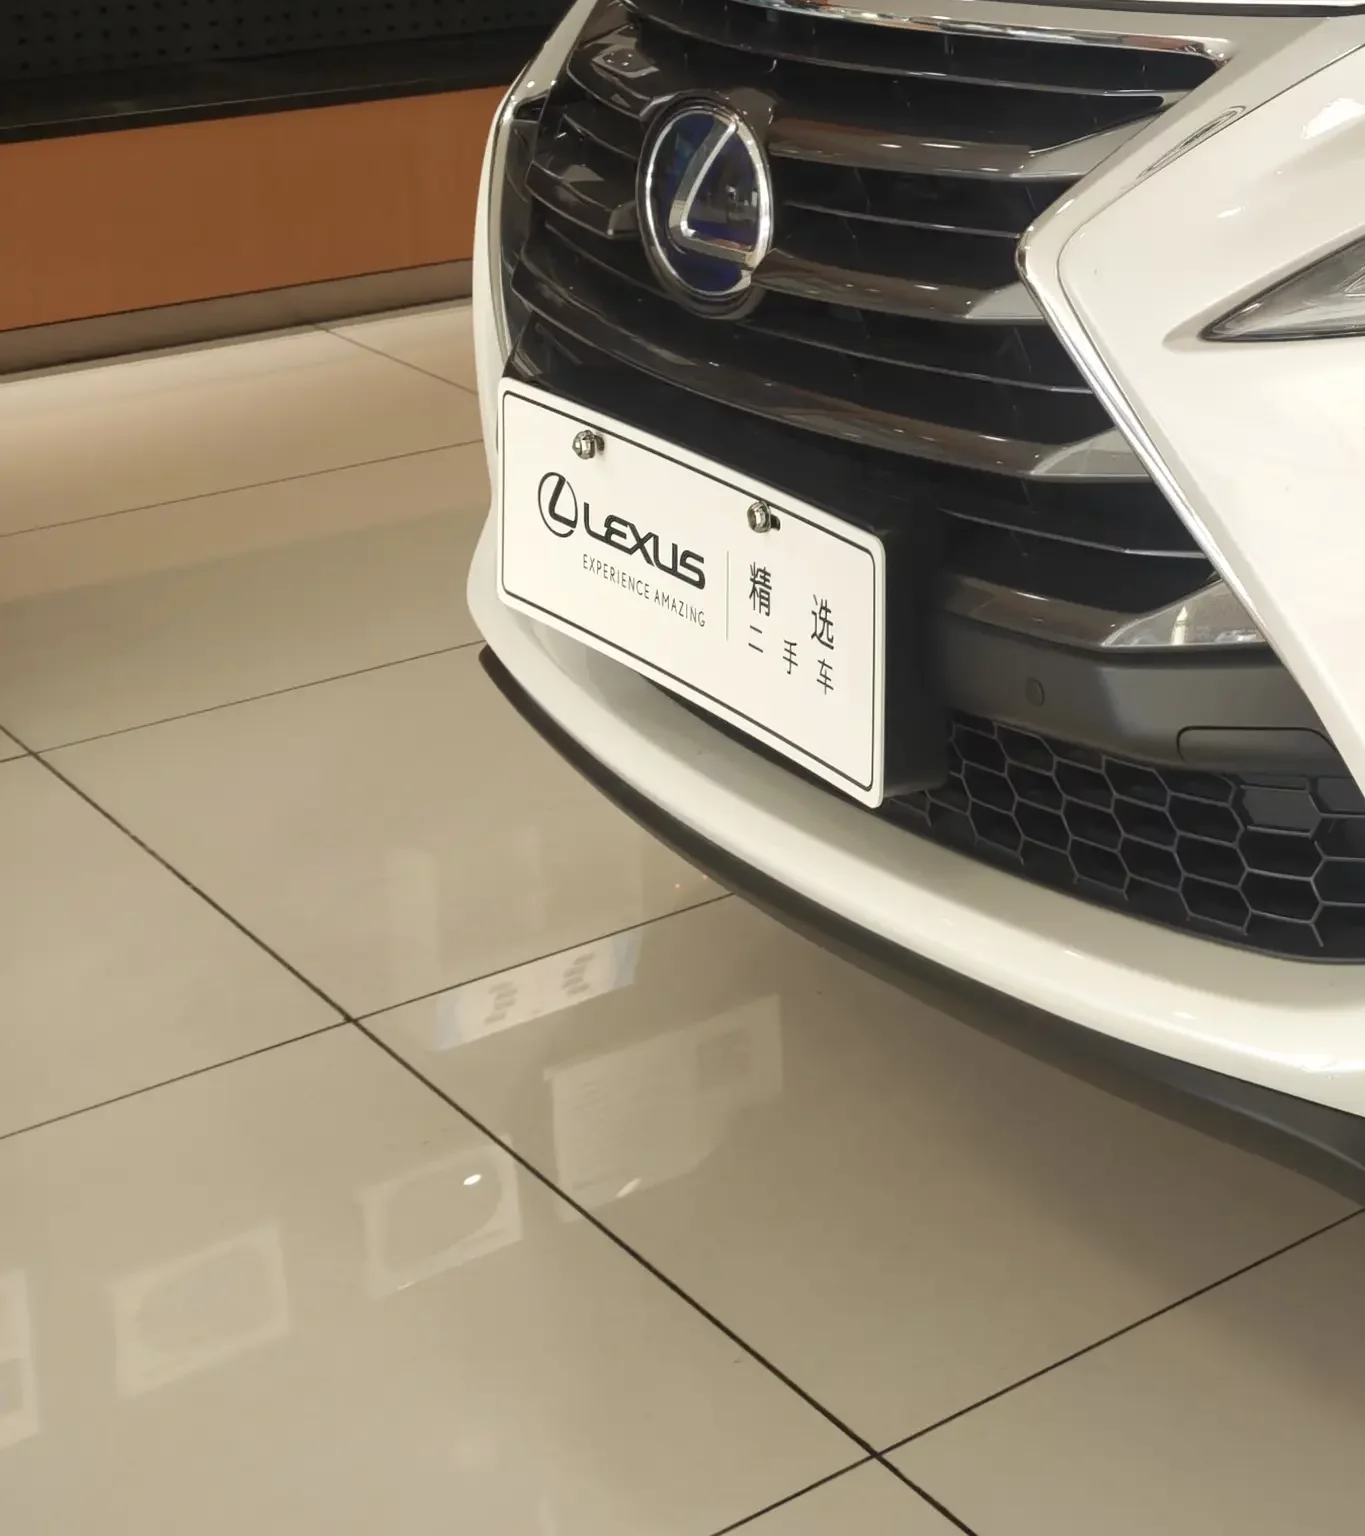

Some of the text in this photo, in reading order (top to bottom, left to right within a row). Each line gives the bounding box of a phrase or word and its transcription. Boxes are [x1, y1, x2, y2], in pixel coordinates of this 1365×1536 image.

[583, 501, 706, 590] LEXUS
[582, 553, 706, 628] EXPERIENCE AMAZING
[748, 561, 835, 651] 精选
[747, 624, 835, 696] 二手车
